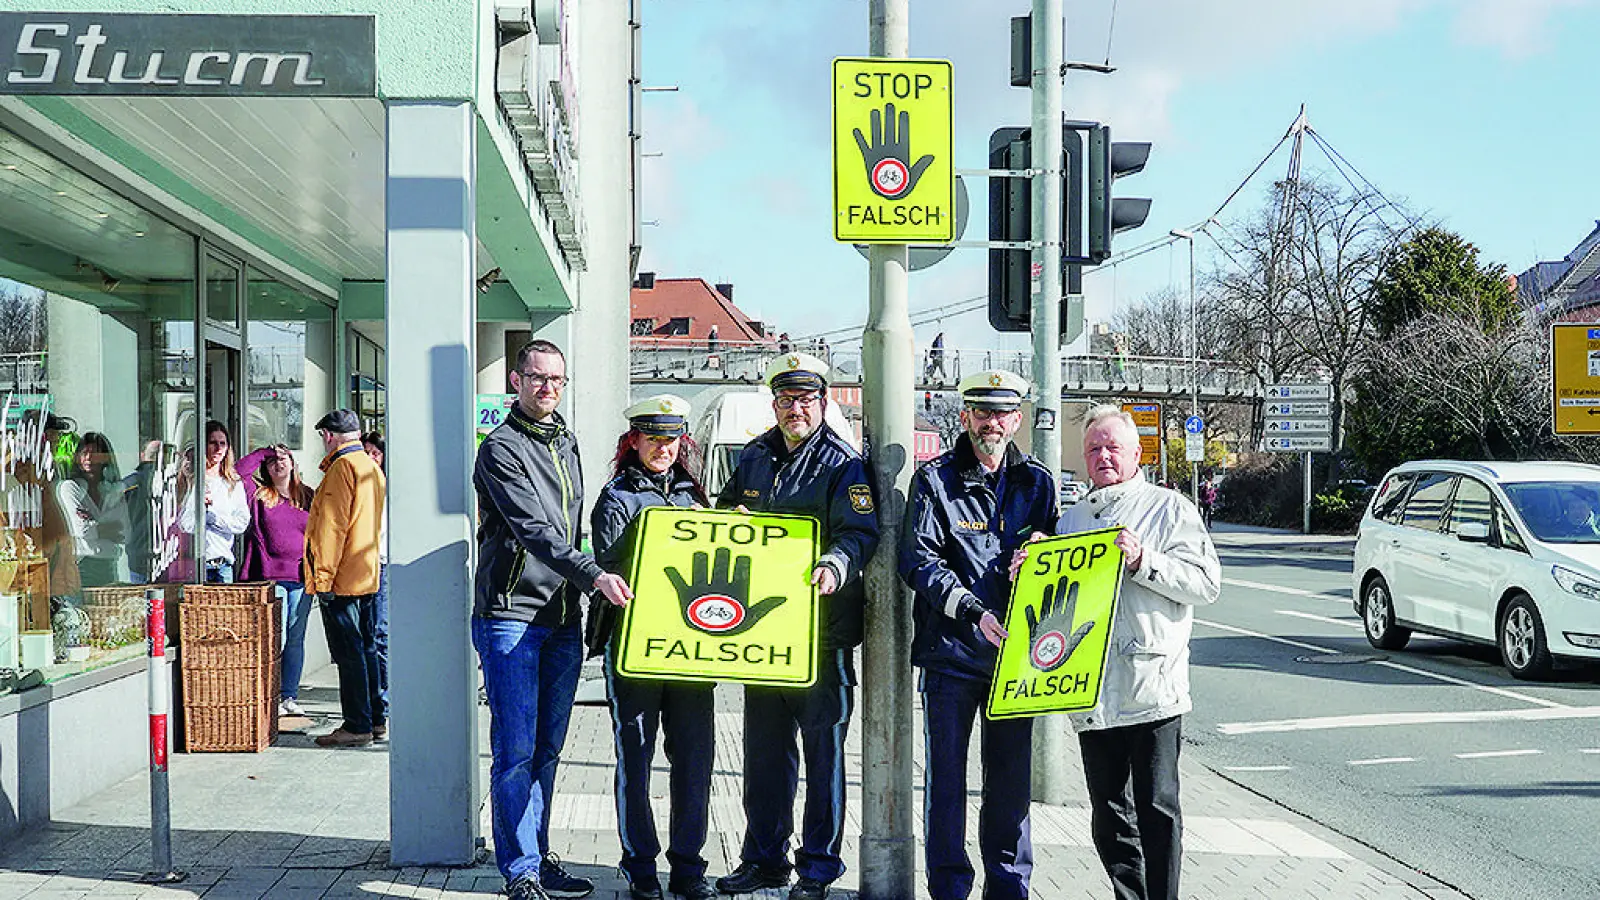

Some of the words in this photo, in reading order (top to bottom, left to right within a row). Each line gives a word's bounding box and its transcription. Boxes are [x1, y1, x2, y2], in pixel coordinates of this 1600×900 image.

[854, 72, 932, 99] STOP
[848, 205, 940, 225] FALSCH
[671, 519, 789, 546] STOP
[1034, 543, 1108, 576] STOP
[644, 638, 792, 665] FALSCH
[1002, 672, 1090, 701] FALSCH
